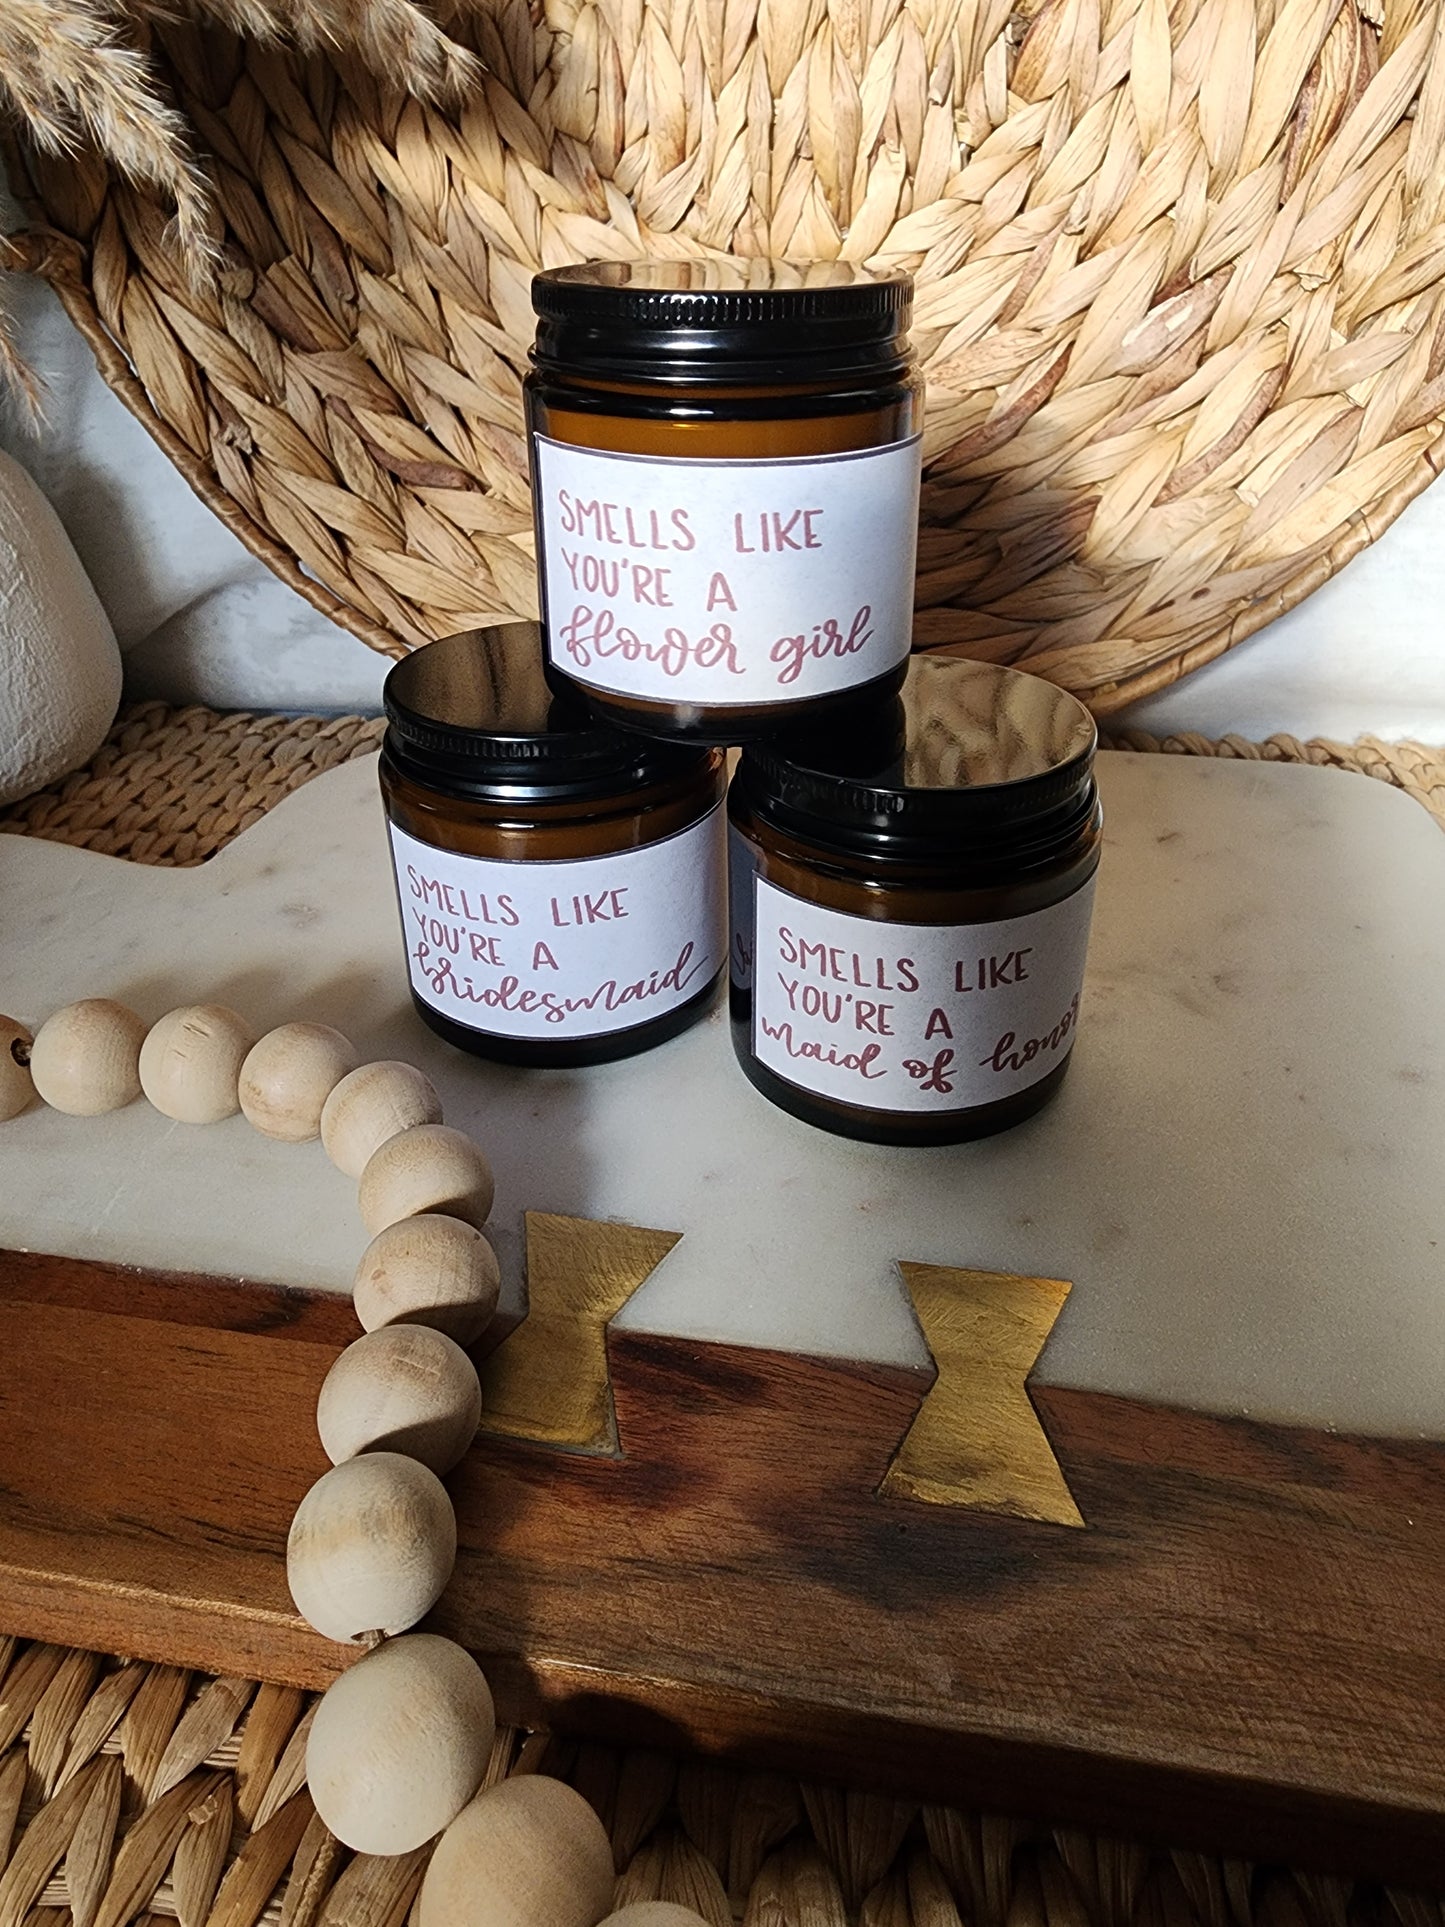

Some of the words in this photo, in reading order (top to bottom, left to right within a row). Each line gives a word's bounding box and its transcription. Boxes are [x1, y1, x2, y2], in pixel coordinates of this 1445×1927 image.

[559, 489, 695, 550] SMELLS
[734, 509, 824, 553] LIKE
[561, 547, 674, 607] YOU'RE
[706, 572, 738, 612] A
[560, 605, 747, 676] flower
[769, 605, 875, 684] girl
[407, 864, 519, 926] SMELLS
[551, 887, 630, 927] LIKE
[412, 906, 505, 967] YOU'RE
[532, 941, 559, 971] A
[779, 926, 920, 992] SMELLS
[954, 947, 1033, 993] LIKE
[413, 941, 708, 1023] bridesmaid
[778, 972, 896, 1036] YOU'RE
[924, 1007, 954, 1041] A
[761, 1016, 888, 1079] maid
[902, 1048, 958, 1094] of
